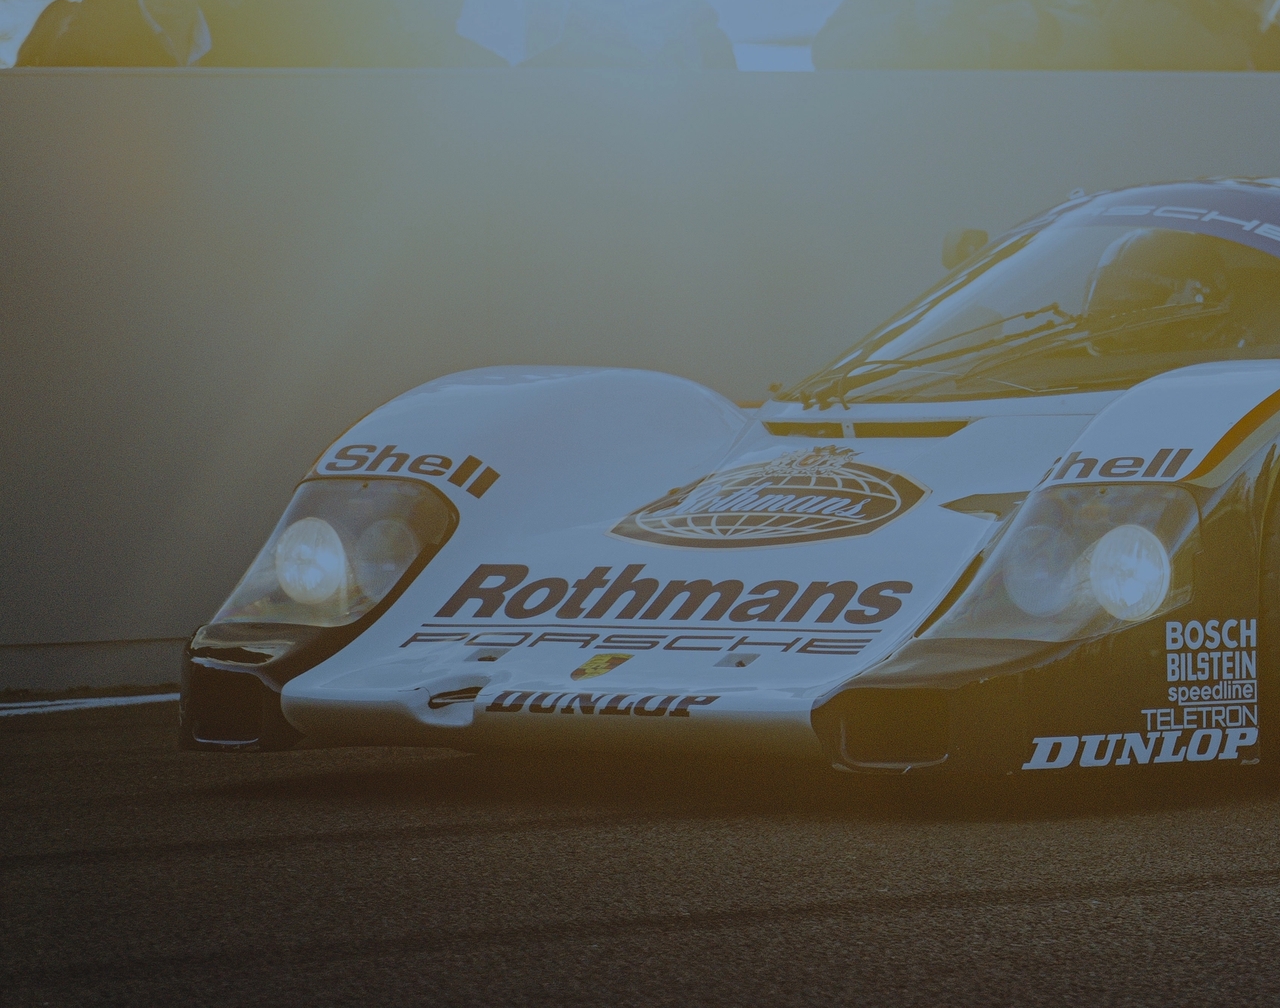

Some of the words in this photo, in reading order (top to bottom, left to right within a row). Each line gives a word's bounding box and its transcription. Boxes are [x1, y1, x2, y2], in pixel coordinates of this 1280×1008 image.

[325, 443, 501, 499] Shell
[1046, 448, 1194, 481] hell
[656, 481, 870, 519] Rothmans
[434, 563, 914, 624] Rothmans
[399, 631, 874, 655] PORSCHE
[1165, 618, 1257, 650] BOSCH
[1166, 650, 1257, 682] BILSTEIN
[485, 690, 721, 717] DUNLOP
[1168, 680, 1254, 702] speedline
[1141, 704, 1258, 731] TELETRON
[1021, 727, 1259, 770] DUNLOP
